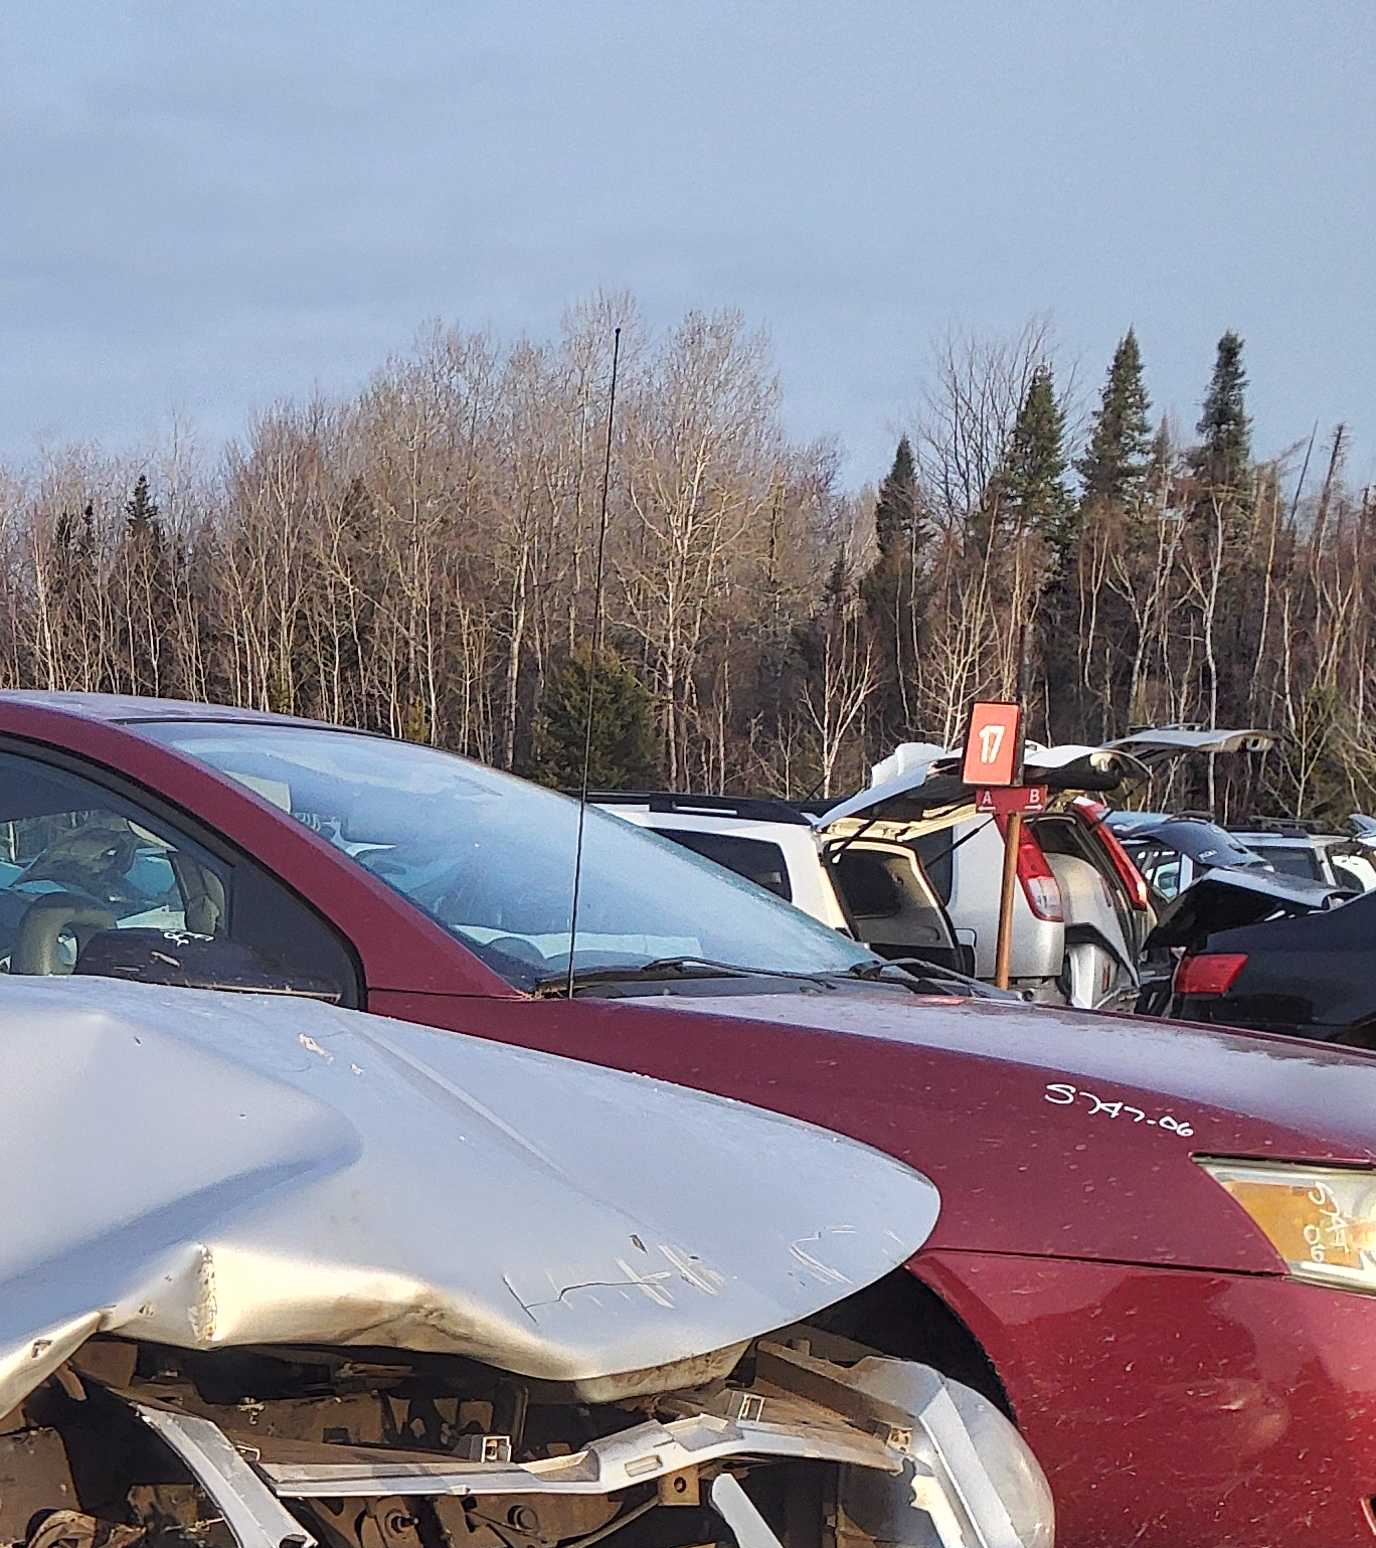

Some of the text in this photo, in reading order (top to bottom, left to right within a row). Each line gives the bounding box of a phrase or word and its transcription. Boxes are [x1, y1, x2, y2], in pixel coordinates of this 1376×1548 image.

[979, 724, 1005, 764] 17
[982, 790, 993, 805] A
[1029, 788, 1041, 804] B
